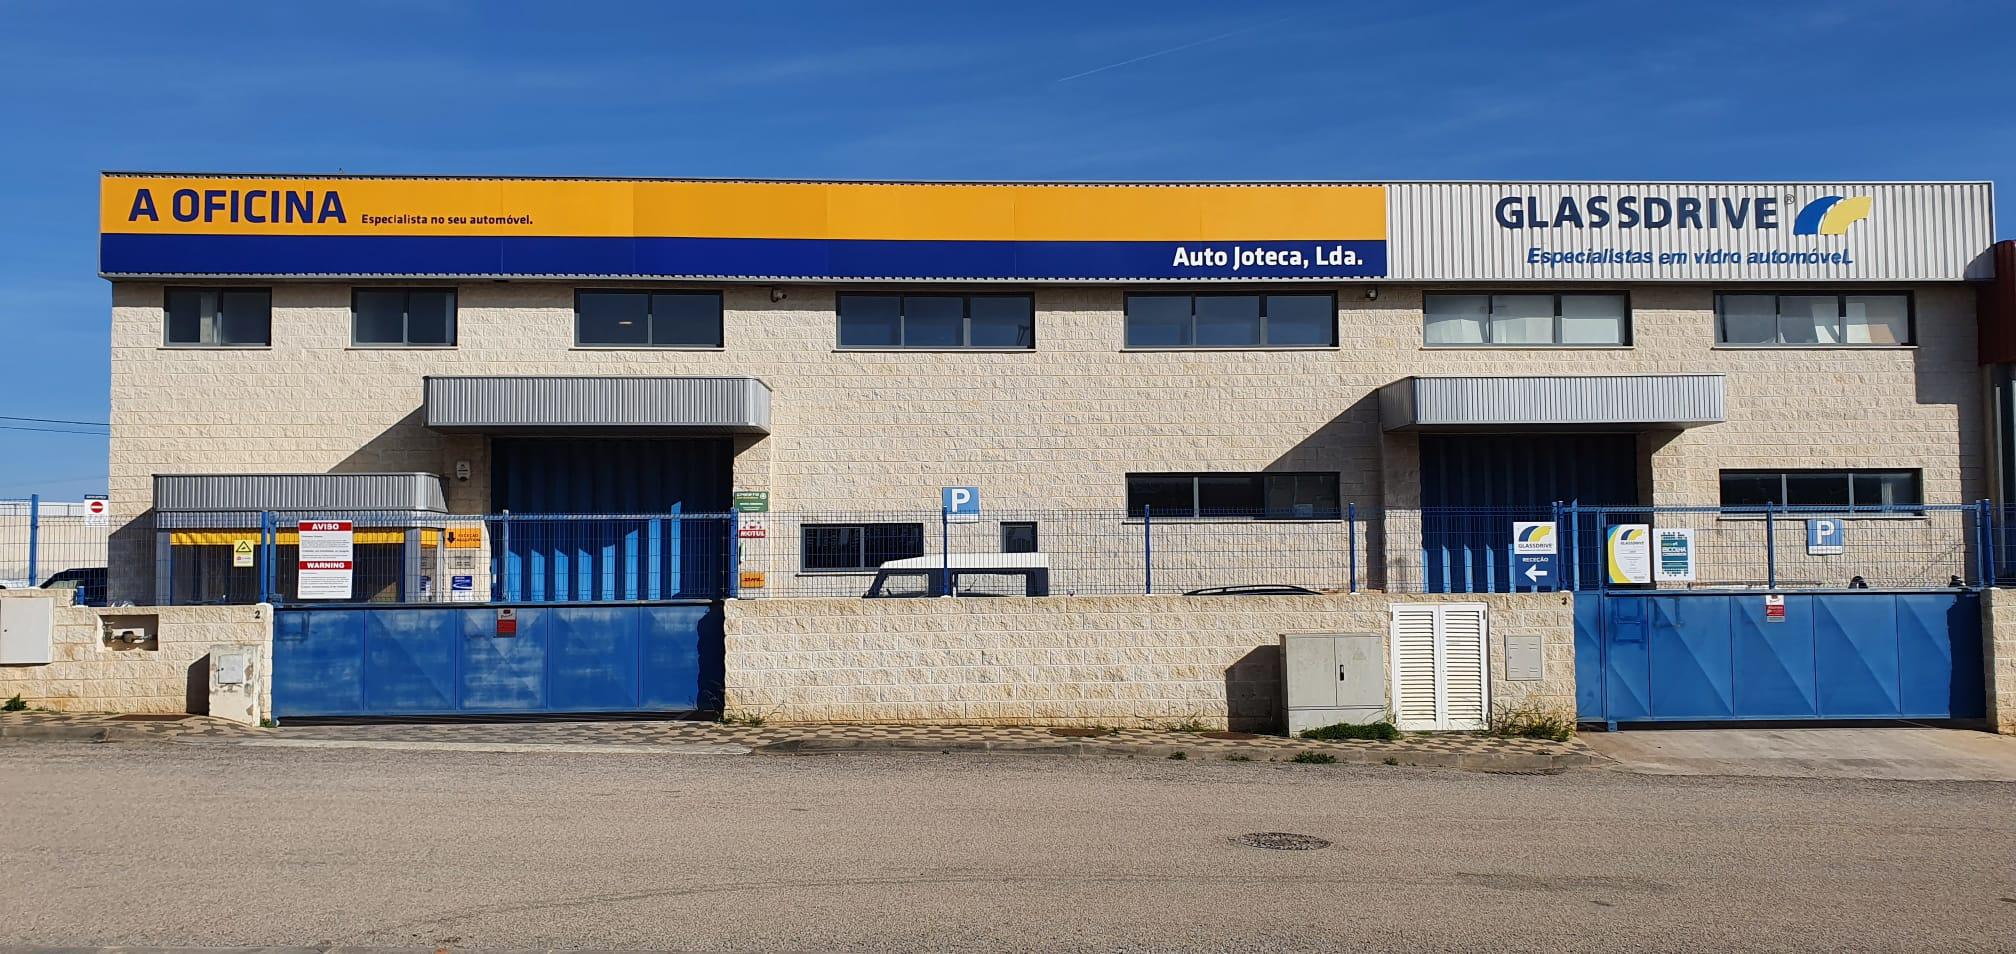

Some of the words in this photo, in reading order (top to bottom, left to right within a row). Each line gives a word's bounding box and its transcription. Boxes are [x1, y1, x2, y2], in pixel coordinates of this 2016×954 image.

[128, 188, 160, 222] A
[172, 188, 347, 224] OFICINA
[1494, 195, 1779, 230] GLASSDRIVE
[361, 213, 428, 227] Especialista
[430, 217, 445, 225] no
[447, 216, 467, 225] seu
[469, 214, 534, 225] automóvel.
[1172, 246, 1228, 267] Auto
[1232, 246, 1309, 271] Joteca,
[1315, 245, 1363, 266] Lda.
[1526, 247, 1654, 269] Especialistas
[1658, 251, 1688, 265] em
[1694, 248, 1742, 265] vidro
[951, 488, 971, 513] P
[1816, 520, 1835, 545] P
[254, 609, 261, 619] 2
